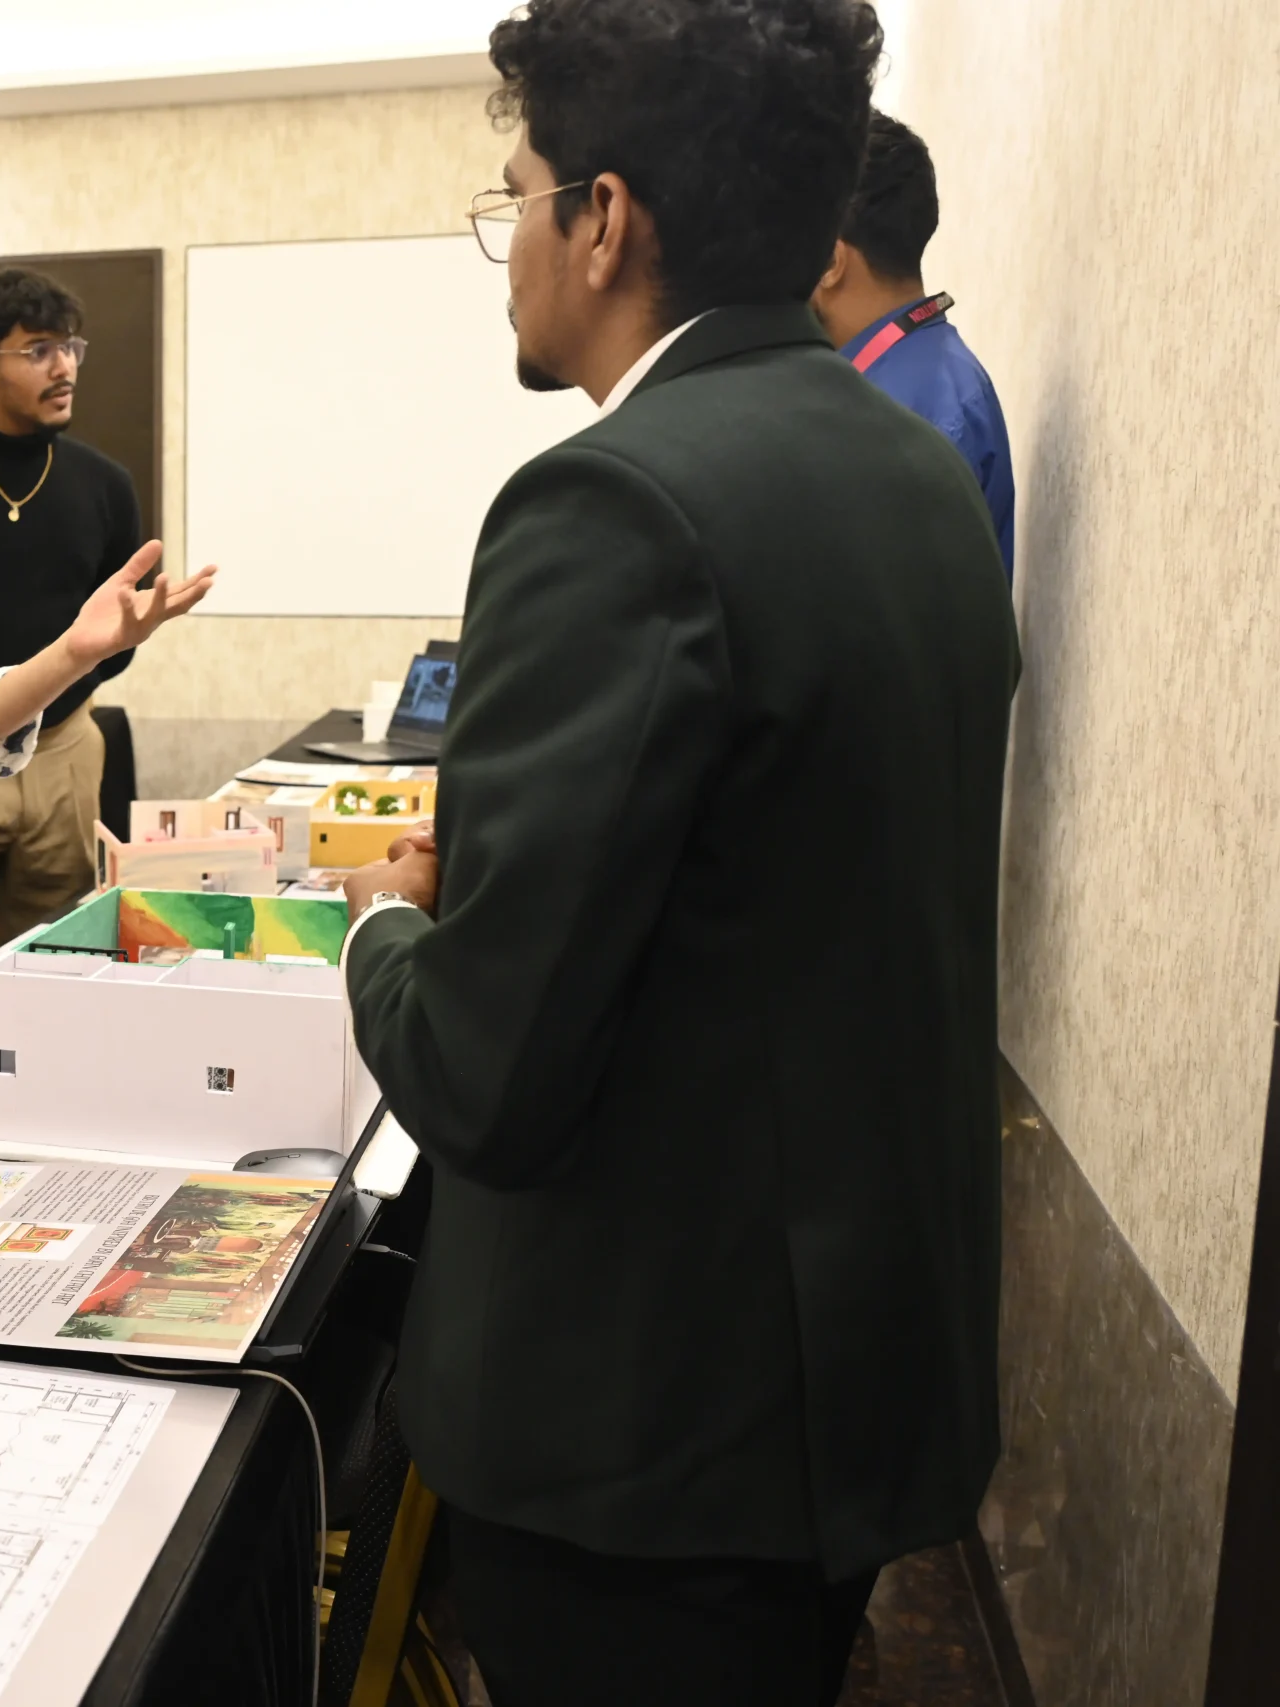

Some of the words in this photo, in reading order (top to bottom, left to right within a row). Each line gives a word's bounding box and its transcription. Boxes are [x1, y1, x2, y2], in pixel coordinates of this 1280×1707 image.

[100, 1226, 133, 1247] INSPIRED
[80, 1255, 108, 1269] GOAN
[61, 1270, 95, 1292] CHITARI
[49, 1292, 75, 1305] ART
